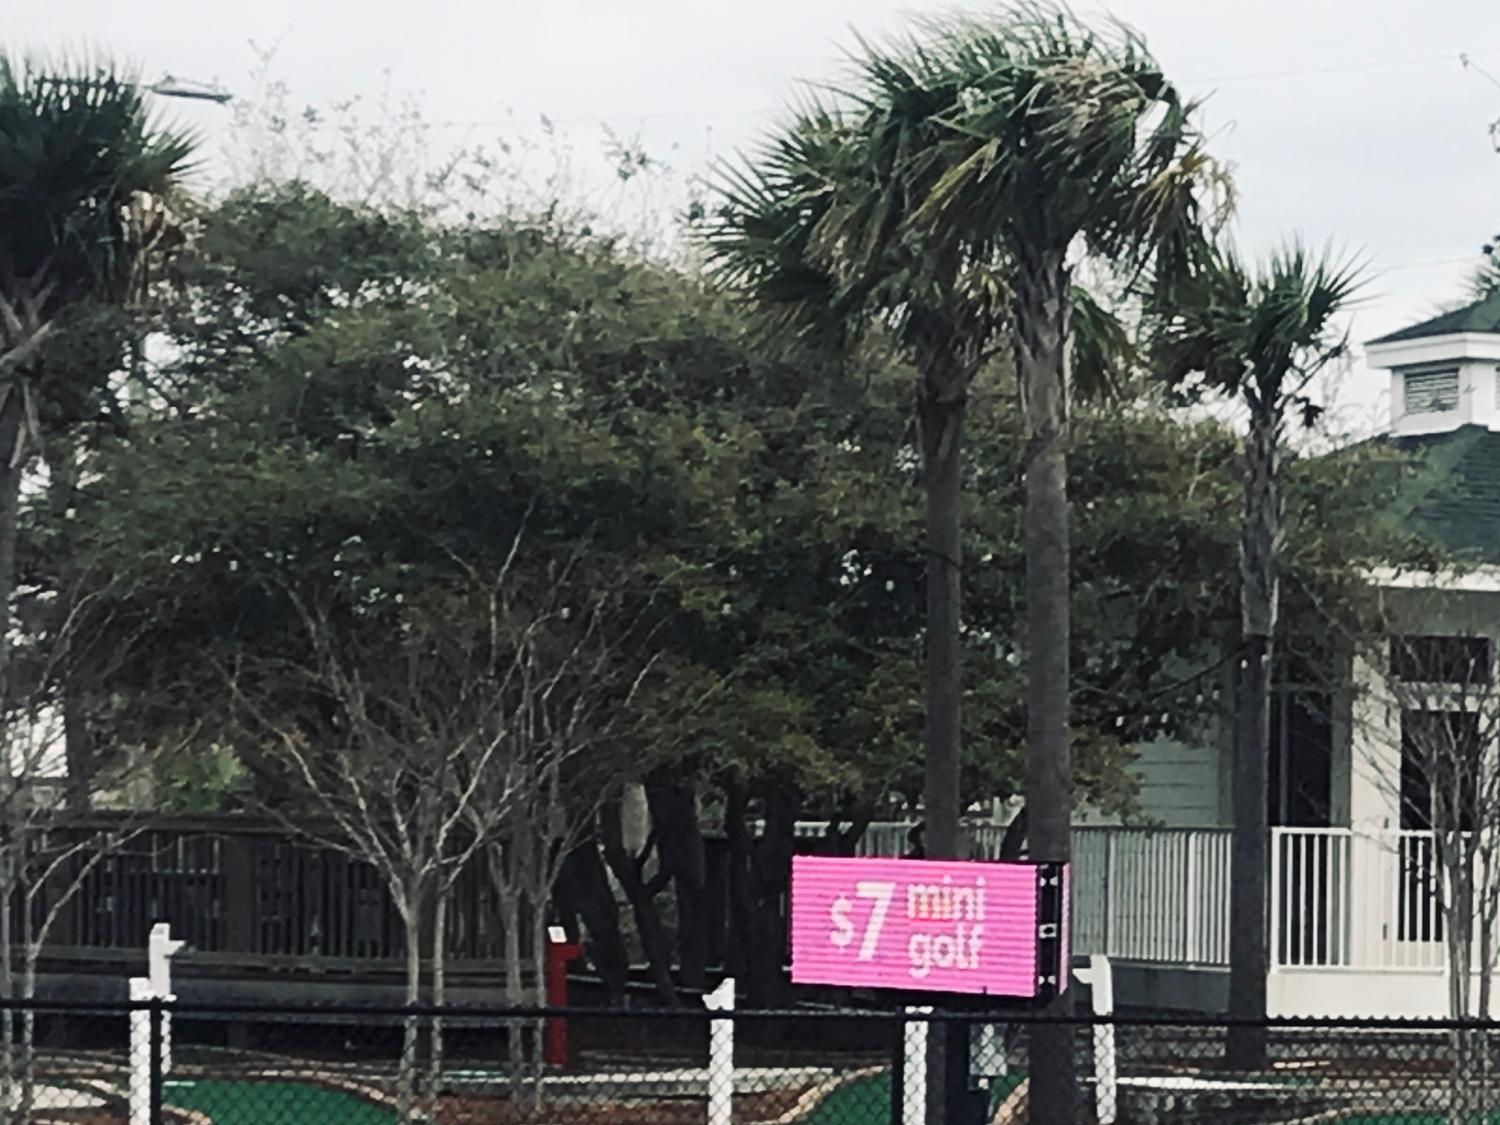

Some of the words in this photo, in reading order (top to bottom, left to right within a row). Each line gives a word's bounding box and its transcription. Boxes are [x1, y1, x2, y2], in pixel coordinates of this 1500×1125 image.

[830, 880, 896, 961] $7
[907, 874, 986, 920] mini
[908, 921, 984, 979] golf
